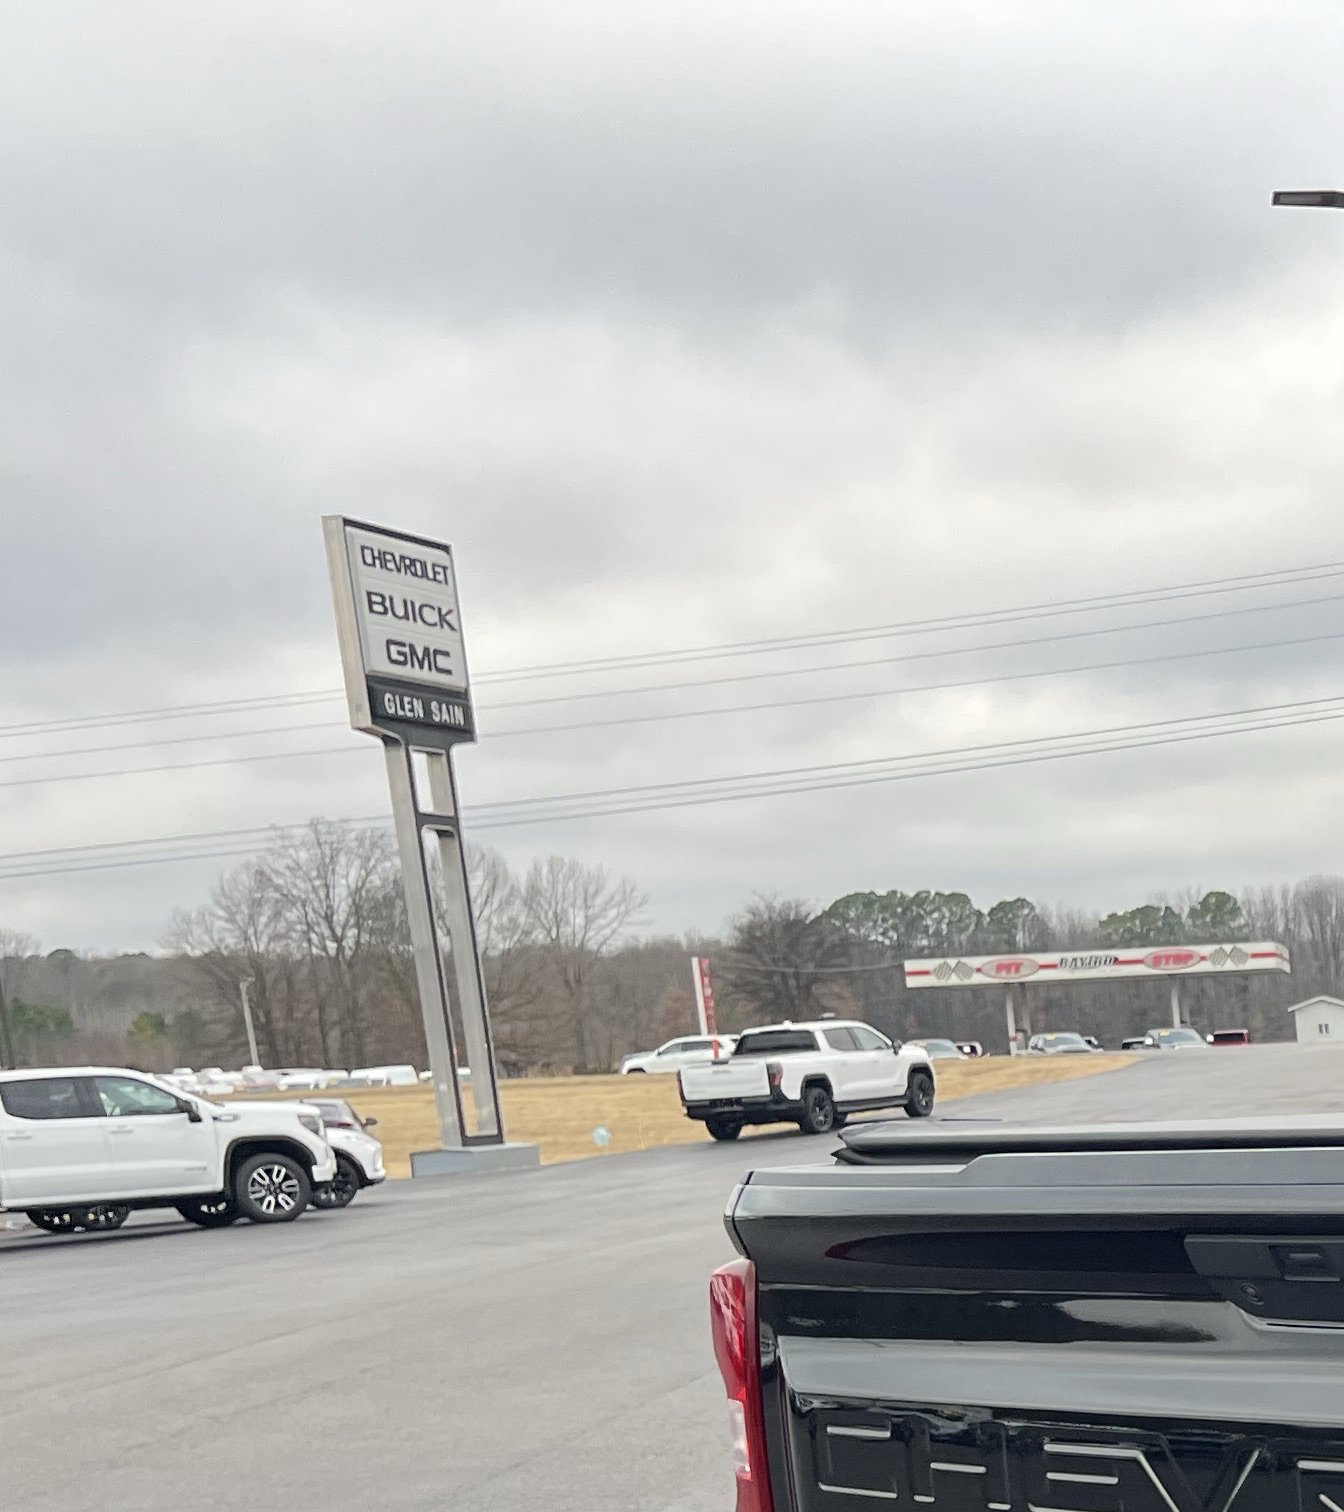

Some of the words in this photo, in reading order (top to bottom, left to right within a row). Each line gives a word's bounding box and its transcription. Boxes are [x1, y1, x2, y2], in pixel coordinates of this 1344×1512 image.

[360, 545, 449, 585] CHEVROLET
[366, 590, 457, 632] BUICK
[385, 638, 453, 676] GMC
[384, 692, 424, 719] GLEN
[431, 701, 465, 726] SAIN
